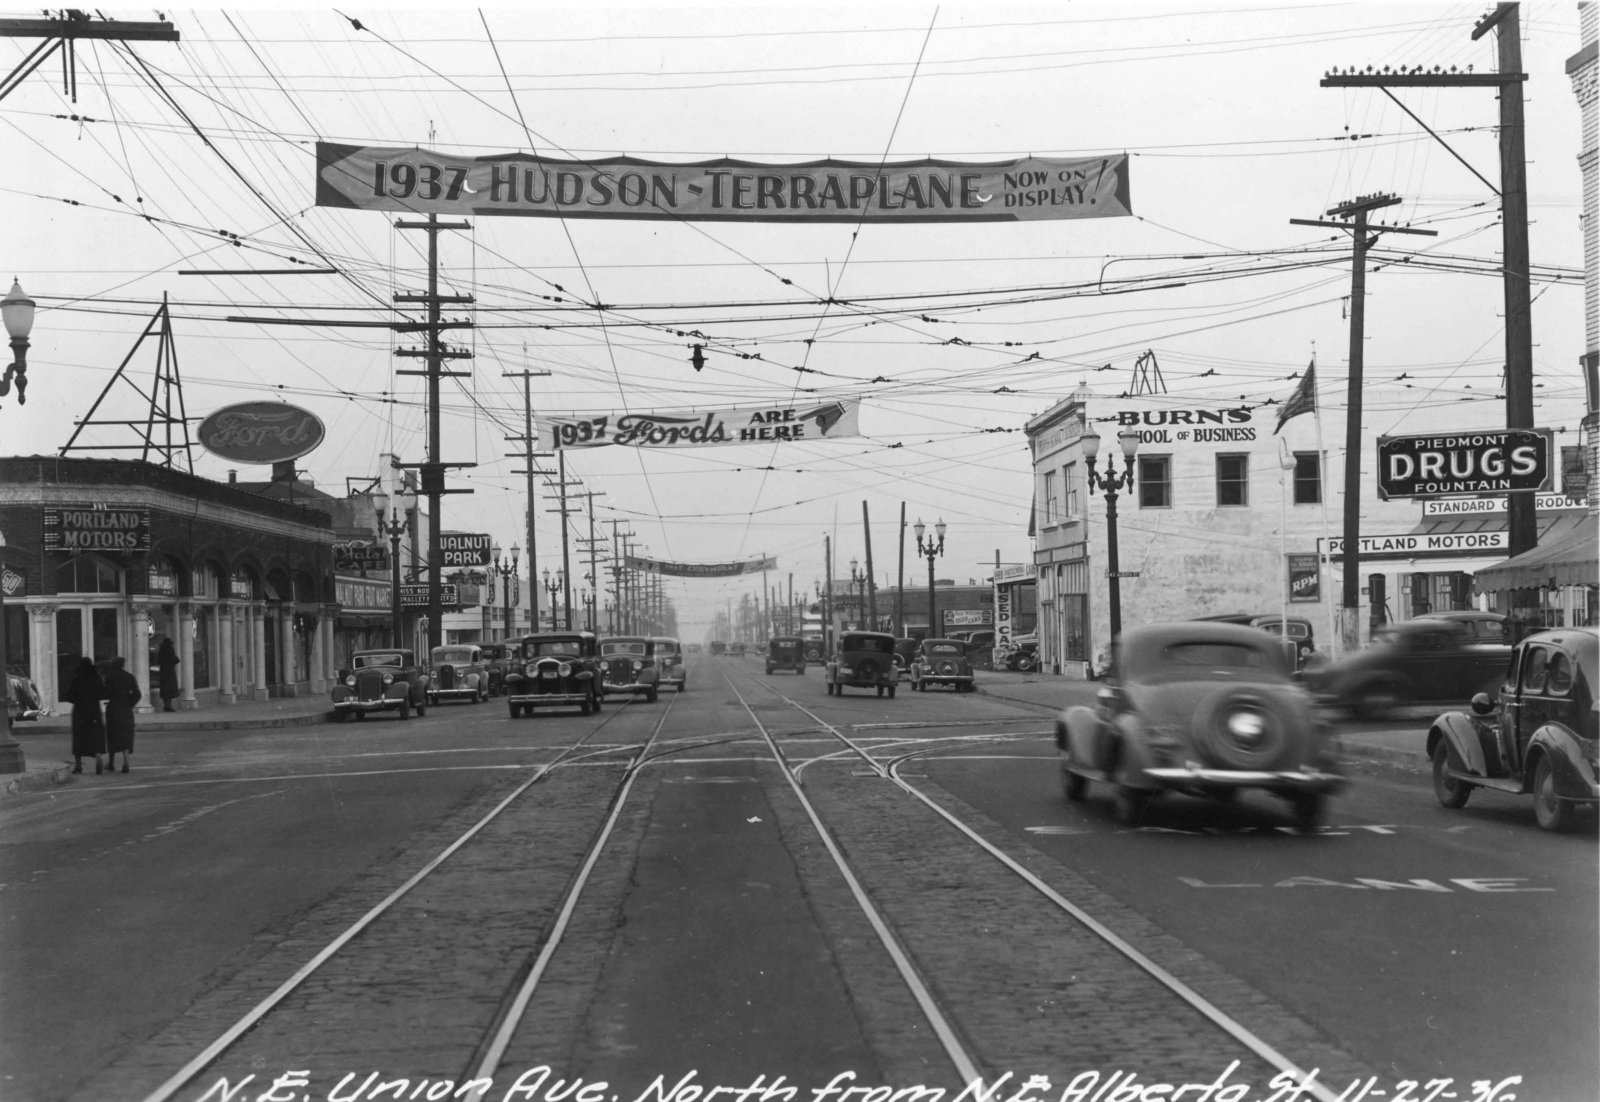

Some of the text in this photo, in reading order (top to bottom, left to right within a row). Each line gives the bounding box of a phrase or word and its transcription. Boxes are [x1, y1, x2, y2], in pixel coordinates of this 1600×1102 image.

[373, 160, 472, 200] 1937
[1003, 169, 1087, 189] NOW ON
[749, 408, 797, 424] ARE
[1117, 408, 1253, 426] BURNS
[208, 411, 312, 447] Ford
[552, 412, 733, 449] 1937 Fords
[740, 423, 805, 441] HERE
[1176, 431, 1190, 441] OF
[1193, 427, 1257, 443] BUSINESS
[1415, 434, 1509, 449] PIEDMONT
[1389, 446, 1538, 481] DRUGS
[1414, 479, 1511, 493] FOUNTAIN
[1429, 500, 1495, 513] STANDARD
[62, 511, 140, 529] PORTLAND
[63, 530, 138, 548] MOTORS
[1428, 534, 1501, 549] MOTORS
[444, 551, 483, 565] PARK
[1292, 573, 1318, 593] RPM
[997, 584, 1010, 622] USED
[1176, 875, 1556, 893] LANE
